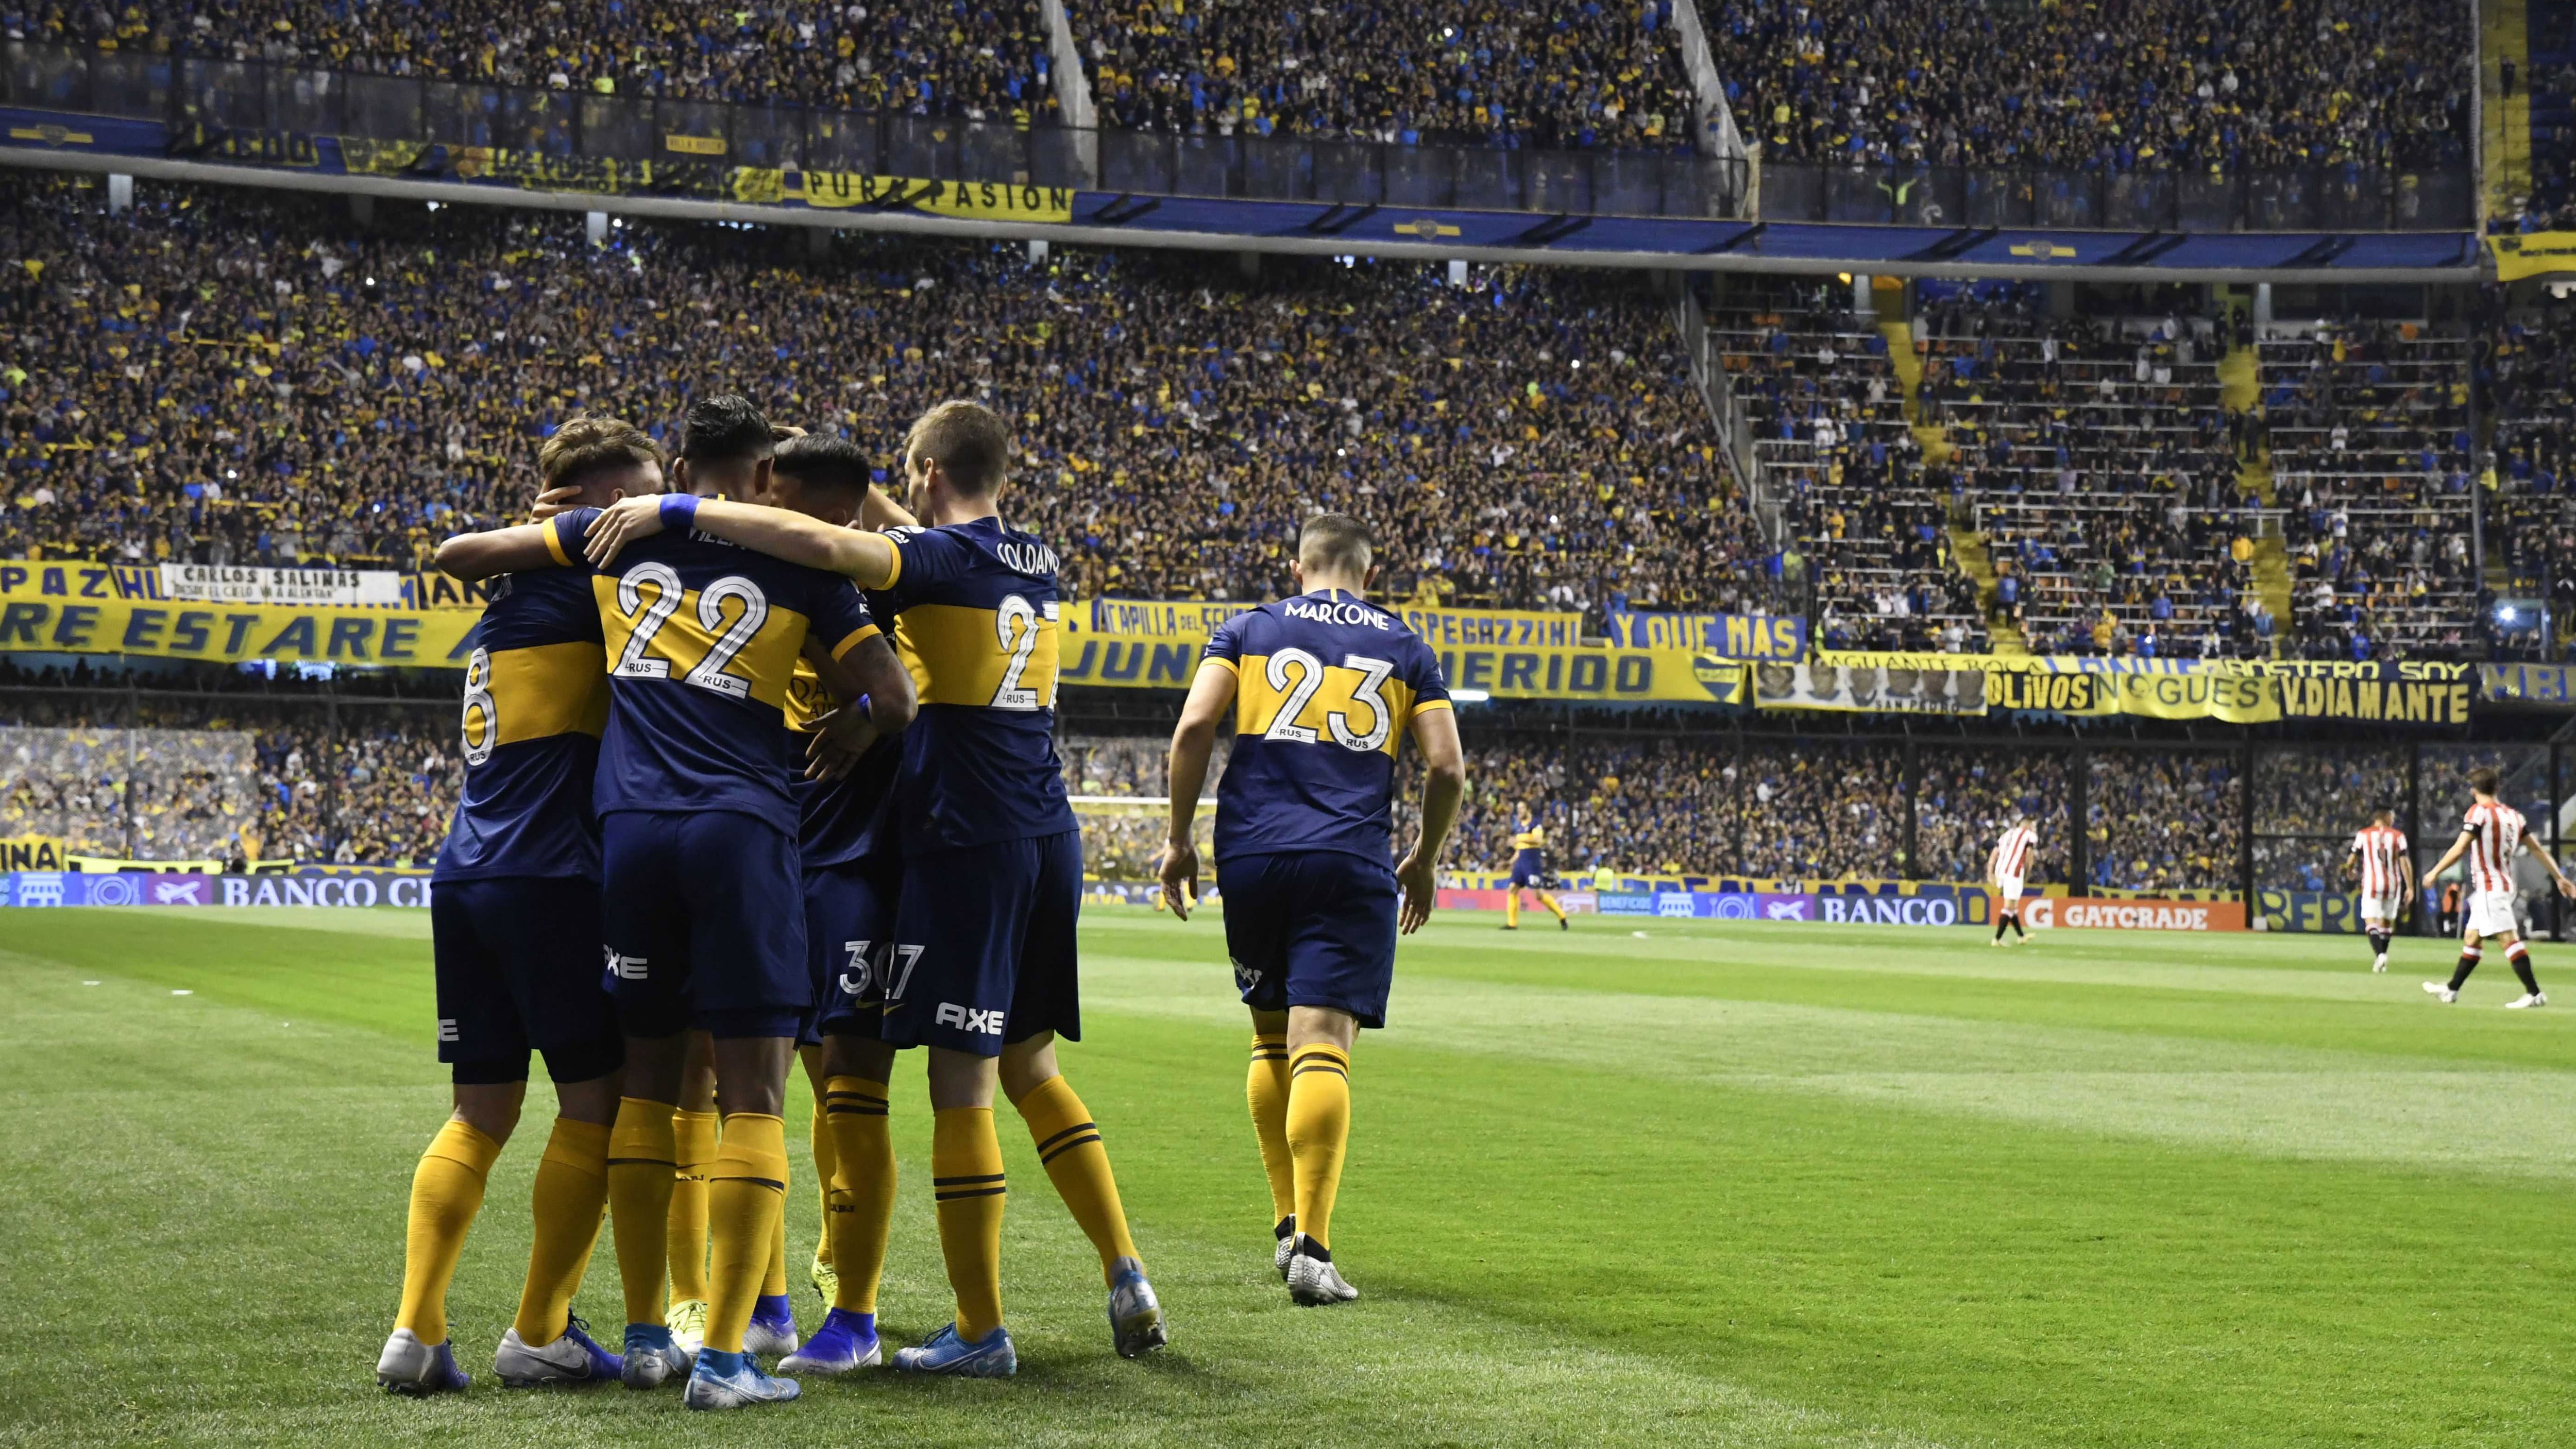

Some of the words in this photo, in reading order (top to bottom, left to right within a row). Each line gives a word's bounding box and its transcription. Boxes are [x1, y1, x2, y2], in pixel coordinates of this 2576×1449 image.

[1, 567, 107, 598] PAZ
[184, 567, 257, 584] CARLOS
[274, 570, 362, 587] SALINAS
[613, 561, 767, 699] 22
[1285, 602, 1389, 631] MARCONE
[1408, 611, 1577, 647] SPEGAZZINI
[123, 608, 420, 658] ESTARE
[1614, 613, 1634, 649] Y
[1646, 615, 1718, 655] QUE
[1726, 616, 1797, 658] MAS
[629, 663, 652, 672] RUS
[1060, 640, 1208, 682] JUN
[703, 675, 732, 689] RUS
[462, 647, 497, 766] 8
[1006, 695, 1025, 704] RUS
[1264, 647, 1394, 752] 23
[2280, 676, 2469, 723] V.DIAMANTE
[1279, 727, 1302, 738] RUS
[1346, 738, 1369, 749] RUS
[469, 751, 486, 762] RUS
[222, 878, 378, 907] BANCO
[1822, 898, 1956, 926] BANCO
[2064, 905, 2208, 930] GATORADE
[935, 1002, 1005, 1035] AXE
